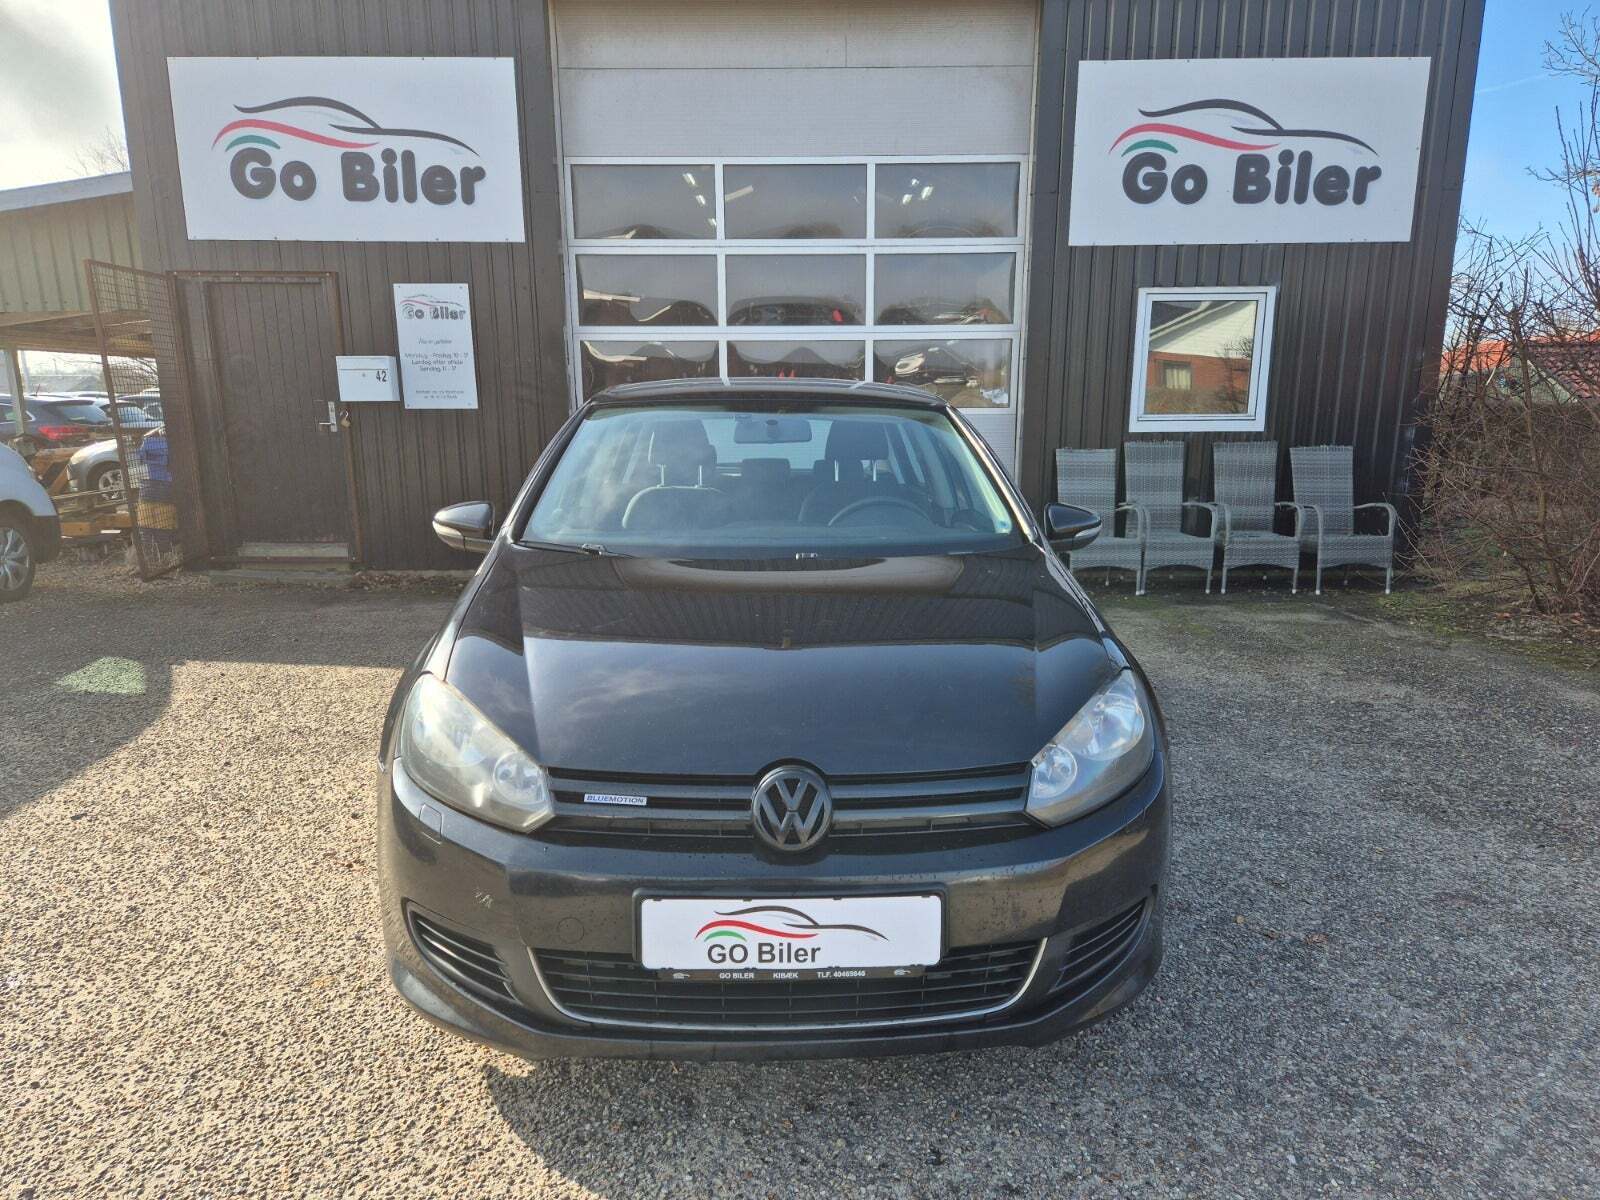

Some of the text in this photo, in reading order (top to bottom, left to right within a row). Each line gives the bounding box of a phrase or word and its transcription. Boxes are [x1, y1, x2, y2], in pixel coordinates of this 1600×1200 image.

[230, 147, 486, 205] Go Biler
[1122, 149, 1382, 206] Go Biler
[376, 370, 387, 382] 42
[586, 795, 645, 804] BLUEMOTION
[707, 942, 821, 964] GO Biler
[733, 971, 755, 979] BILER
